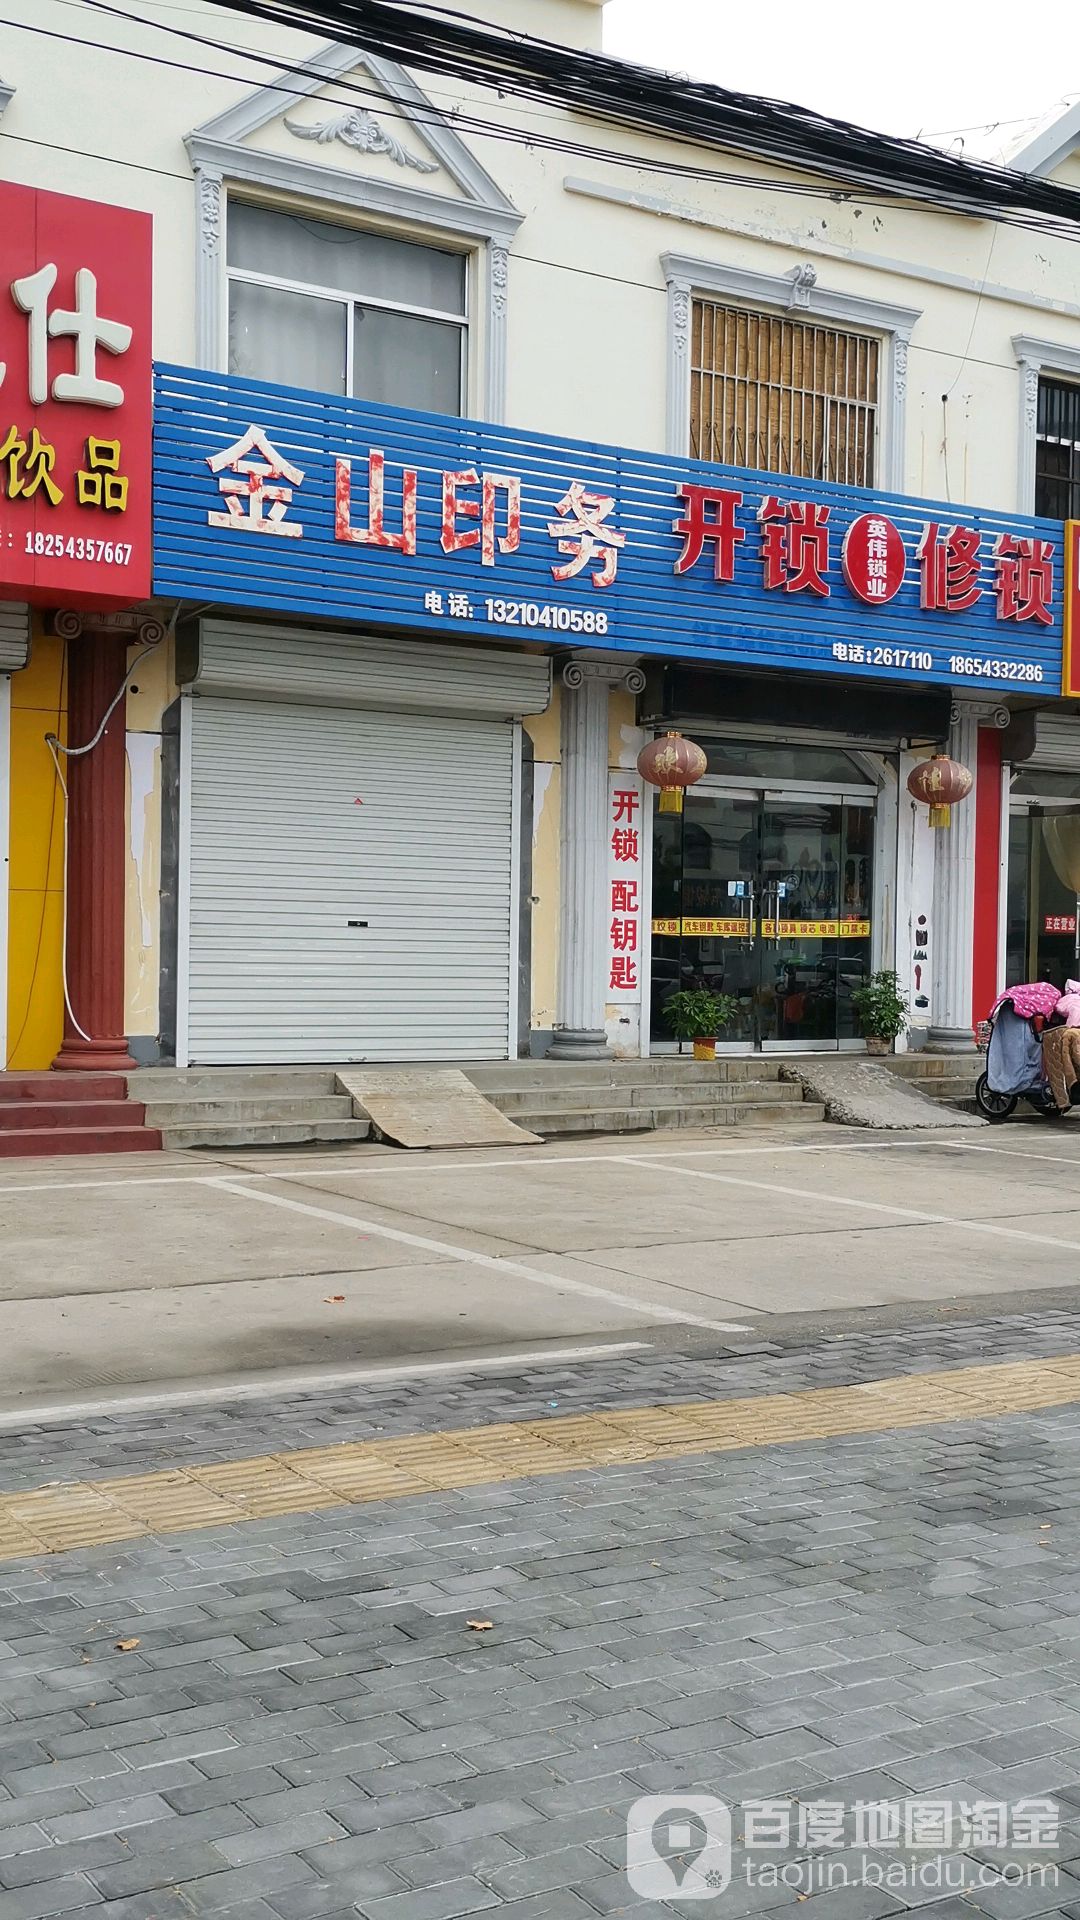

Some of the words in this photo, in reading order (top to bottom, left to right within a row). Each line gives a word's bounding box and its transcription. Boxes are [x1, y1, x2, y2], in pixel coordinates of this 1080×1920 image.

[0, 263, 132, 407] 仕
[0, 425, 129, 511] 饮品
[206, 424, 626, 587] 金山印务
[25, 531, 132, 565] 18254357667
[866, 519, 888, 597] 英伟锁业
[485, 598, 608, 634] 13210410588
[949, 655, 1043, 682] 18654332286
[611, 790, 640, 862] 开锁
[609, 880, 639, 990] 配钥匙
[1045, 917, 1076, 931] 正在营业
